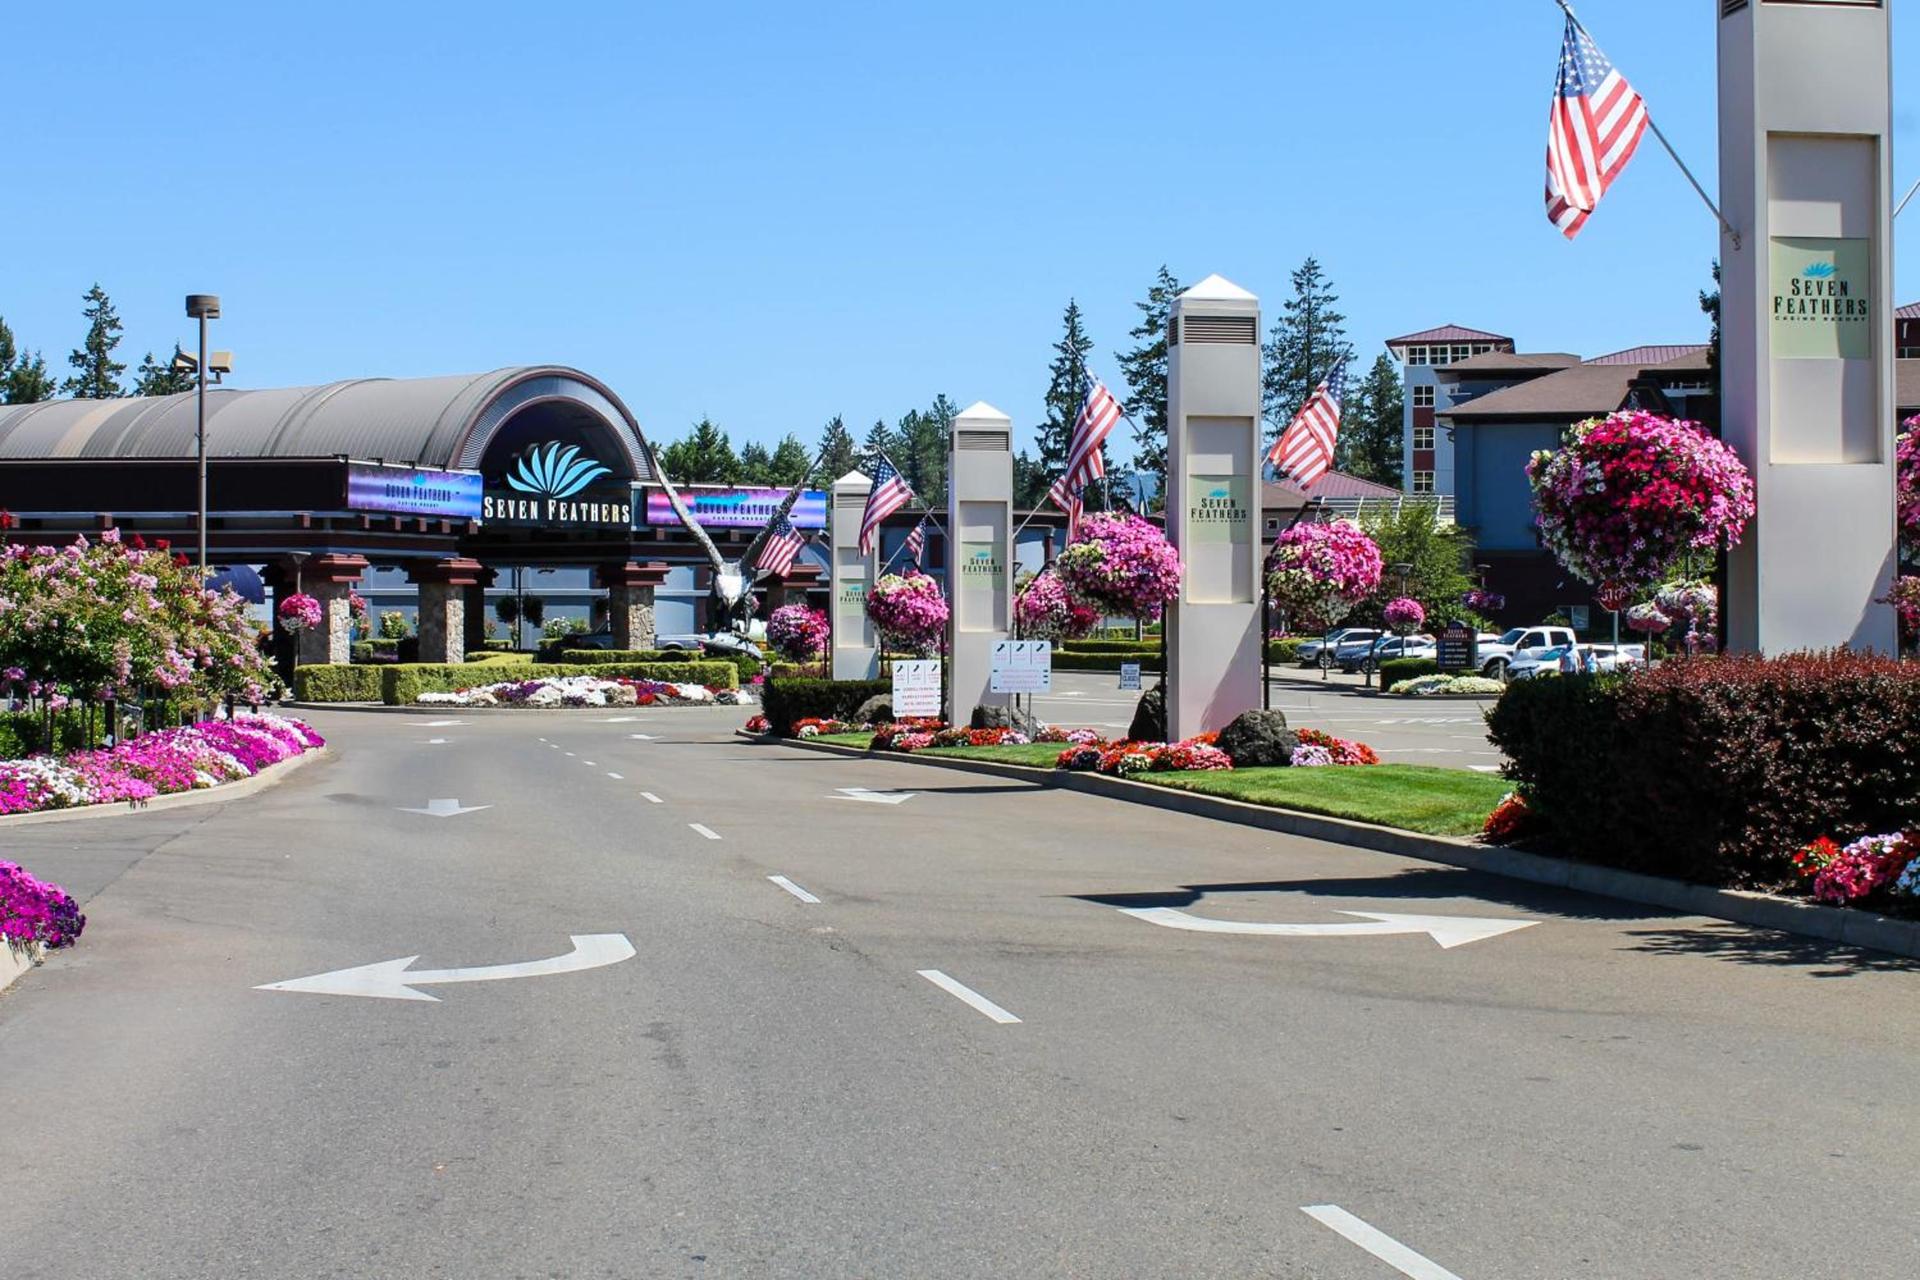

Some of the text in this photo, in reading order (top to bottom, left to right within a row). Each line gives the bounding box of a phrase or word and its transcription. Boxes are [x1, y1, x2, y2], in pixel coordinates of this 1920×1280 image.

[1792, 278, 1848, 296] SEVEN
[1774, 297, 1867, 315] FEATHERS
[484, 497, 630, 523] SEVEN FEATHERS
[733, 503, 779, 515] FEATHER
[1201, 498, 1236, 508] SEVEN
[1191, 508, 1247, 519] FEATHERS
